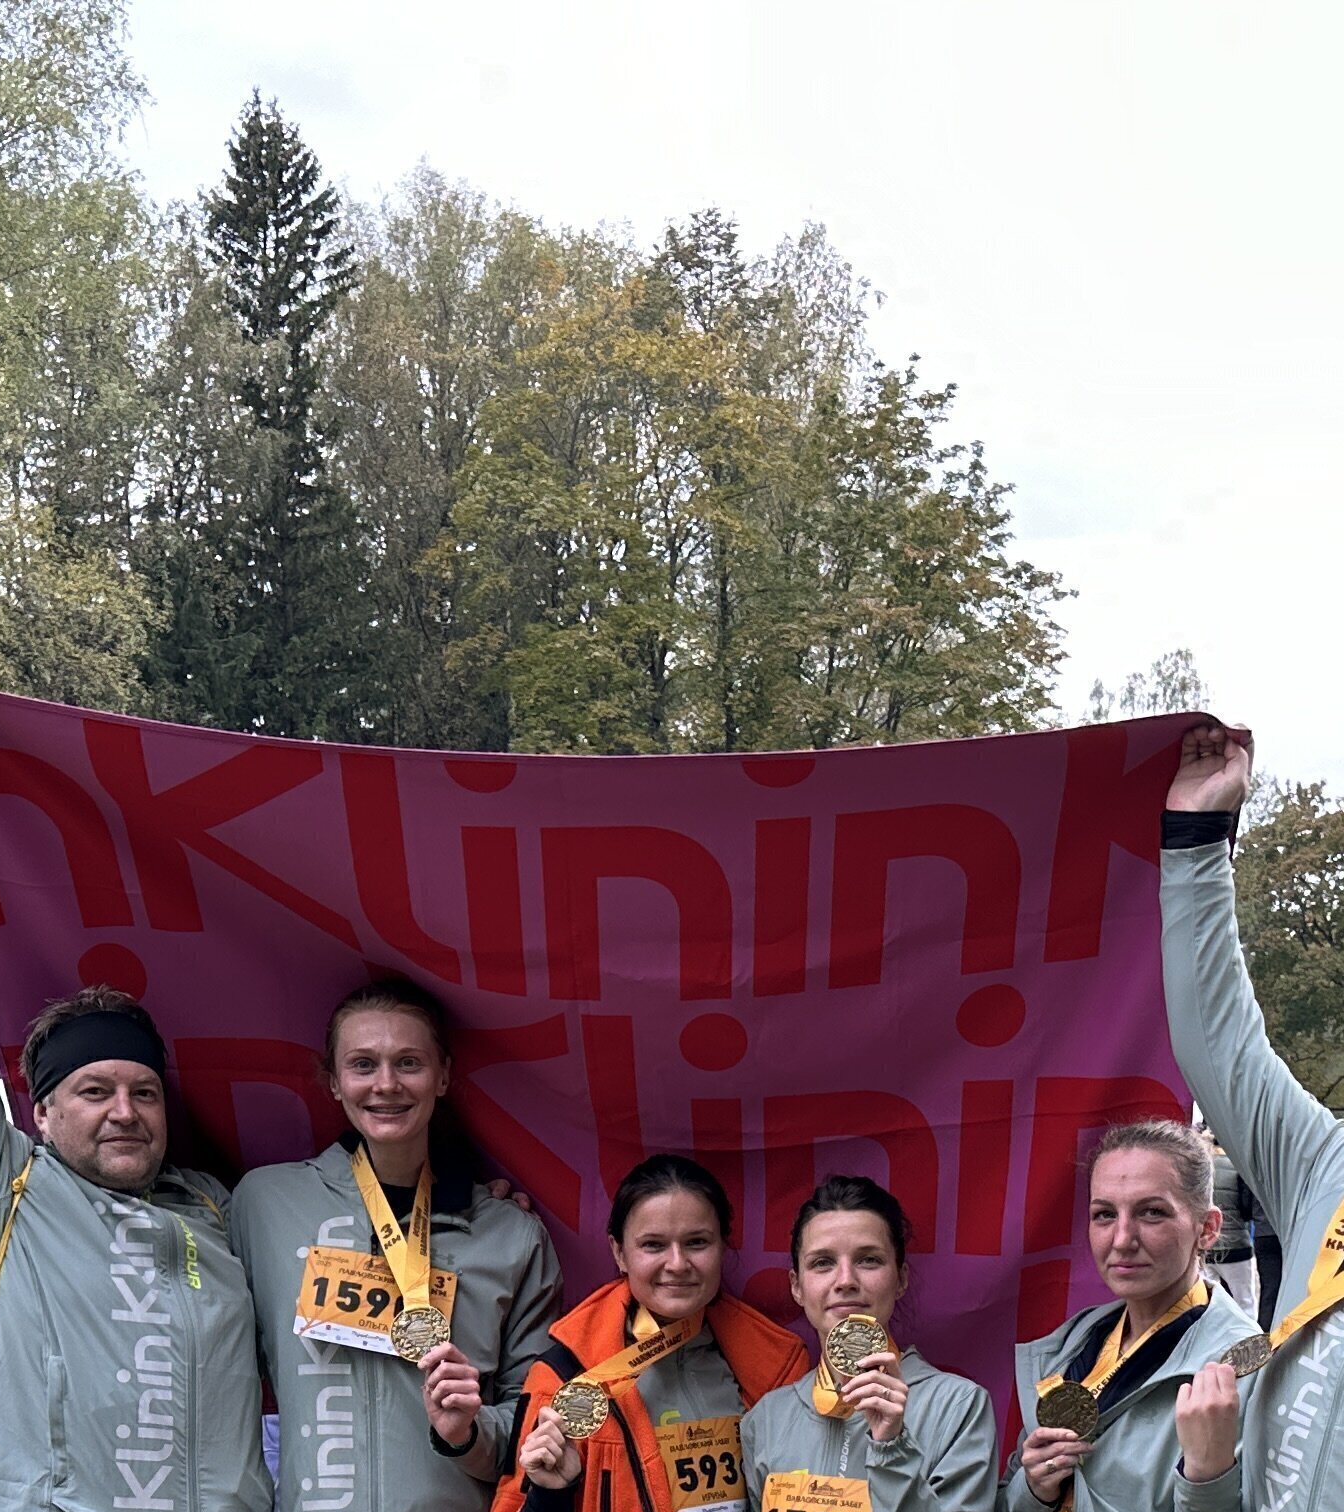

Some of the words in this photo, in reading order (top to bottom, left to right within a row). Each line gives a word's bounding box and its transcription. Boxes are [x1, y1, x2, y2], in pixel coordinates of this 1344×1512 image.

[380, 1223, 393, 1240] 3
[434, 1276, 445, 1289] 3
[358, 1318, 389, 1332] ОЛЬГА
[113, 1335, 174, 1511] Klinin
[674, 1452, 739, 1492] 593
